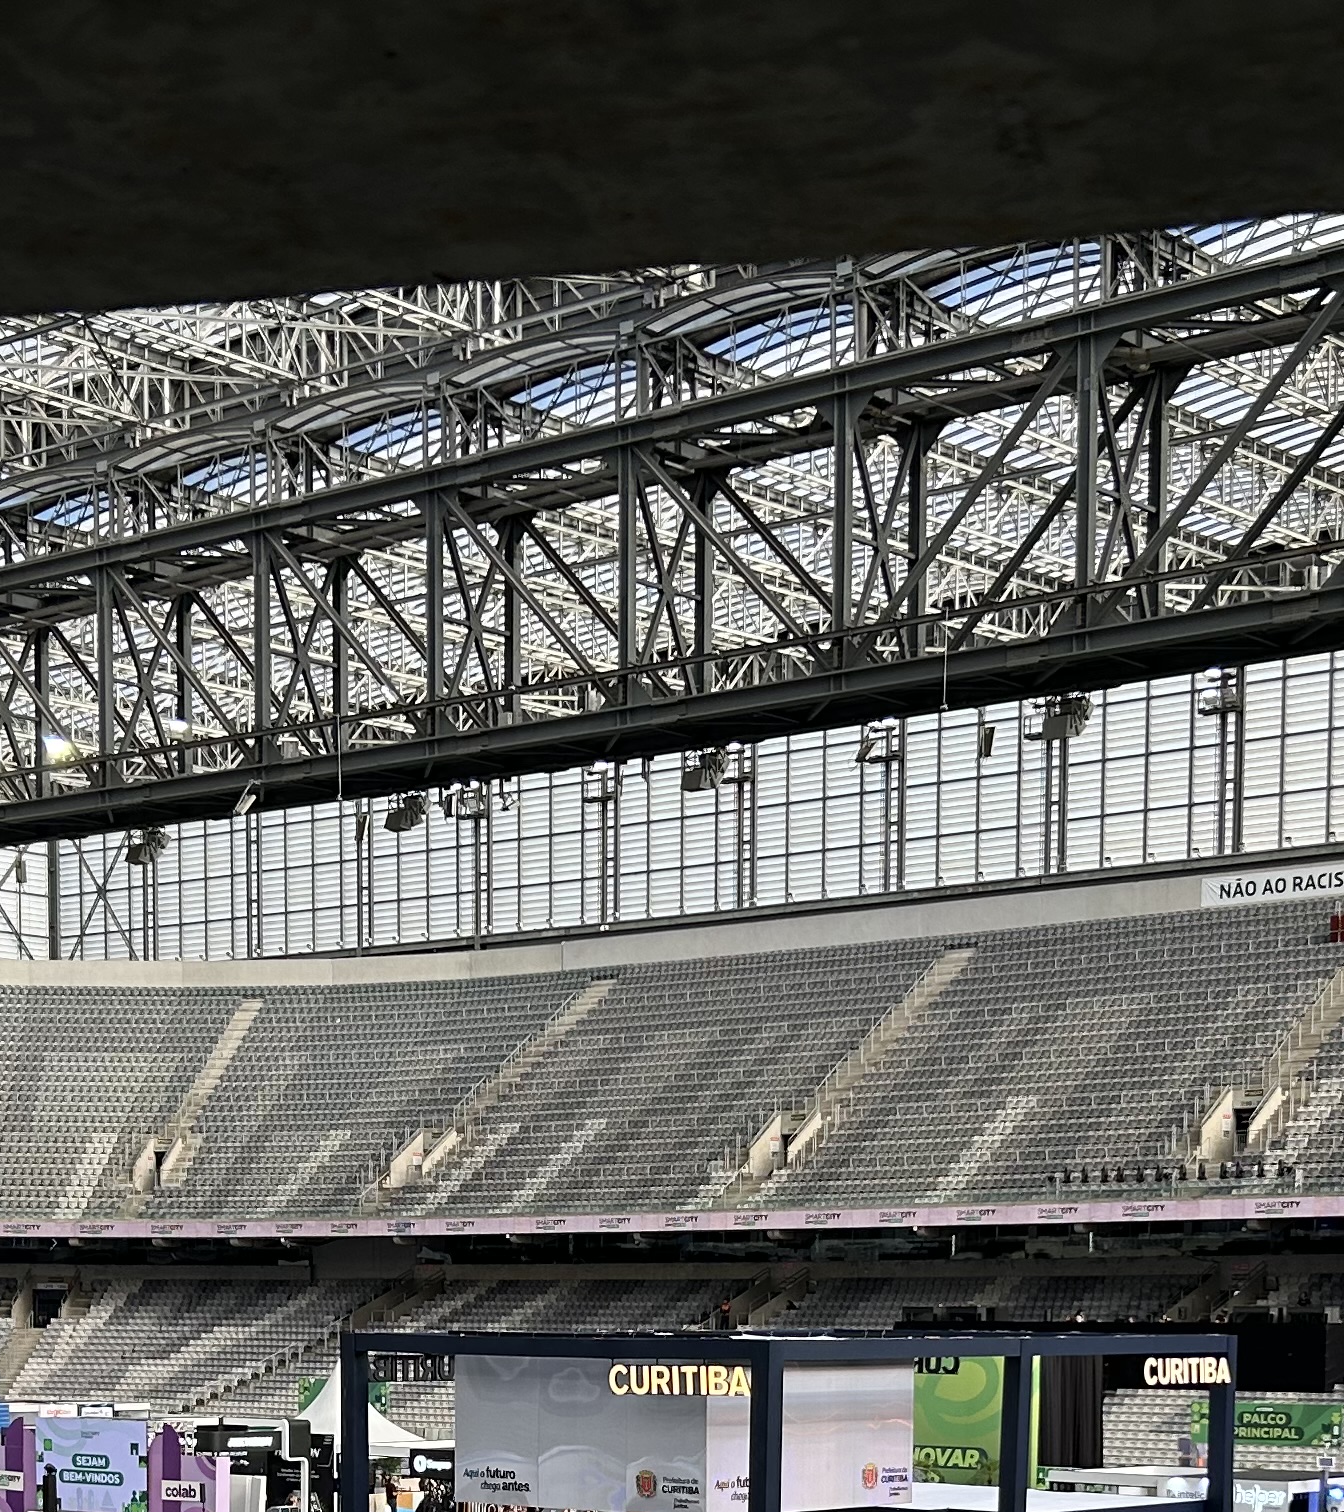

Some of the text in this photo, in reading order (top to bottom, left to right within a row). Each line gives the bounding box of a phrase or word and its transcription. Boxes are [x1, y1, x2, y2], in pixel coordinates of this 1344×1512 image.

[1219, 878, 1257, 899] NÃO
[1262, 877, 1286, 895] AO
[1144, 1357, 1231, 1386] CURITIBA
[609, 1364, 751, 1396] CURITIBA
[1243, 1413, 1286, 1425] PALCO
[76, 1456, 106, 1467] SEJAM
[63, 1471, 120, 1484] BEM-VINDOS
[486, 1467, 516, 1479] futuro
[165, 1485, 197, 1498] colab
[662, 1486, 700, 1495] CURITIBA
